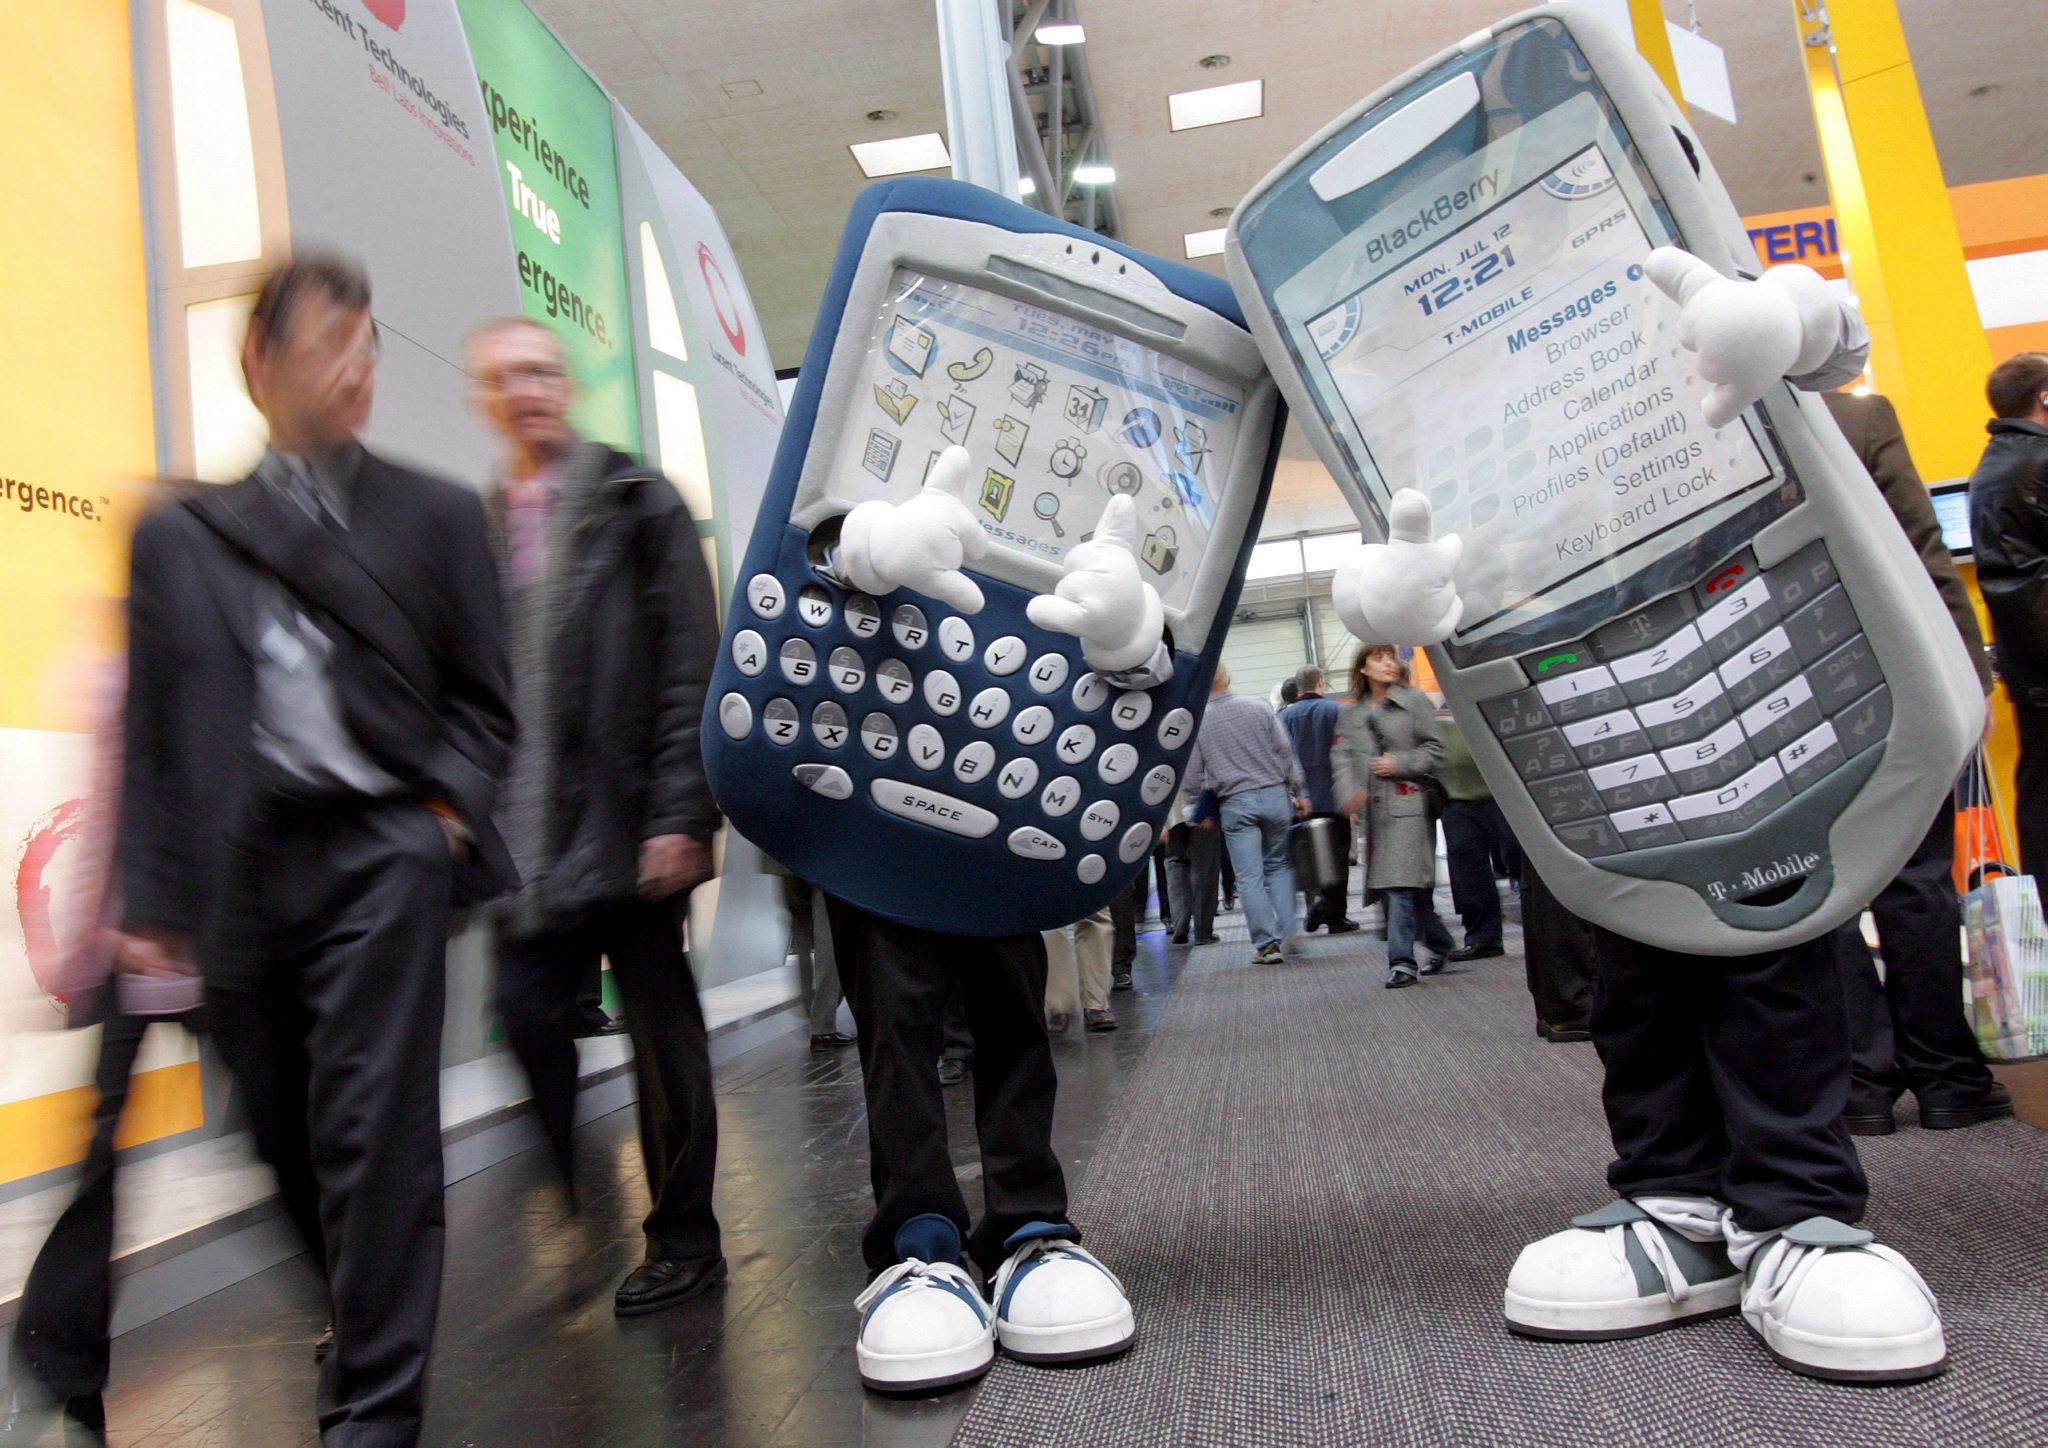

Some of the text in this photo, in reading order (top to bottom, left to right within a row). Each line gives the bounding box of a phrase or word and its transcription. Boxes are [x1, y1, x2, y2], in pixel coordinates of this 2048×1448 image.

[358, 23, 469, 139] Technologies
[506, 160, 560, 245] True
[1365, 168, 1500, 263] BlackBerry
[1572, 208, 1628, 249] GPRS
[1404, 223, 1512, 295] MON. JUL 12
[1418, 245, 1516, 317] 12:21
[1072, 325, 1114, 344] MAY
[1443, 286, 1535, 345] T-MOBILE
[1506, 280, 1616, 354] Messages
[1545, 303, 1631, 364] Browser
[1069, 398, 1089, 417] 31
[1504, 330, 1646, 424] Address Book
[1563, 357, 1658, 420] Calendar
[1513, 410, 1687, 516] Profiles (Default)
[1547, 386, 1674, 465] Applications
[1613, 441, 1702, 496] Settings
[979, 520, 1060, 555] essages
[1555, 467, 1717, 560] Keyboard Lock
[1811, 560, 1830, 583] P
[759, 596, 777, 611] Q
[811, 604, 828, 617] W
[857, 618, 877, 632] E
[905, 630, 922, 644] R
[955, 640, 969, 653] T
[992, 652, 1005, 666] Y
[1036, 666, 1053, 681] U
[1080, 686, 1089, 698] I
[1164, 726, 1180, 738] P
[1560, 702, 1577, 716] E
[1593, 692, 1611, 706] R
[1640, 678, 1657, 694] T
[1675, 662, 1693, 679] Y
[1722, 630, 1741, 649] U
[1571, 597, 1748, 692] 1 2 3
[742, 653, 1172, 785] A S D F G H J K L DEL
[1525, 758, 1542, 774] A
[1551, 753, 1566, 767] S
[1588, 745, 1605, 760] D
[1619, 736, 1637, 753] F
[1666, 724, 1686, 741] G
[1699, 708, 1718, 727] H
[1767, 659, 1788, 681] K
[1818, 629, 1838, 644] L
[1593, 647, 1771, 736] 4 5 6
[1622, 649, 1866, 780] 7 8 9 DEL
[776, 722, 1113, 826] Z X C V B N M SYM
[1548, 782, 1584, 798] SYM
[1552, 803, 1568, 817] Z
[1580, 797, 1596, 812] X
[1614, 788, 1632, 802] C
[1643, 780, 1659, 797] V
[1720, 756, 1741, 773] N
[1775, 718, 1796, 737] M
[903, 796, 962, 821] SPACE
[1032, 836, 1059, 850] CAP
[1706, 800, 1768, 828] SPACE
